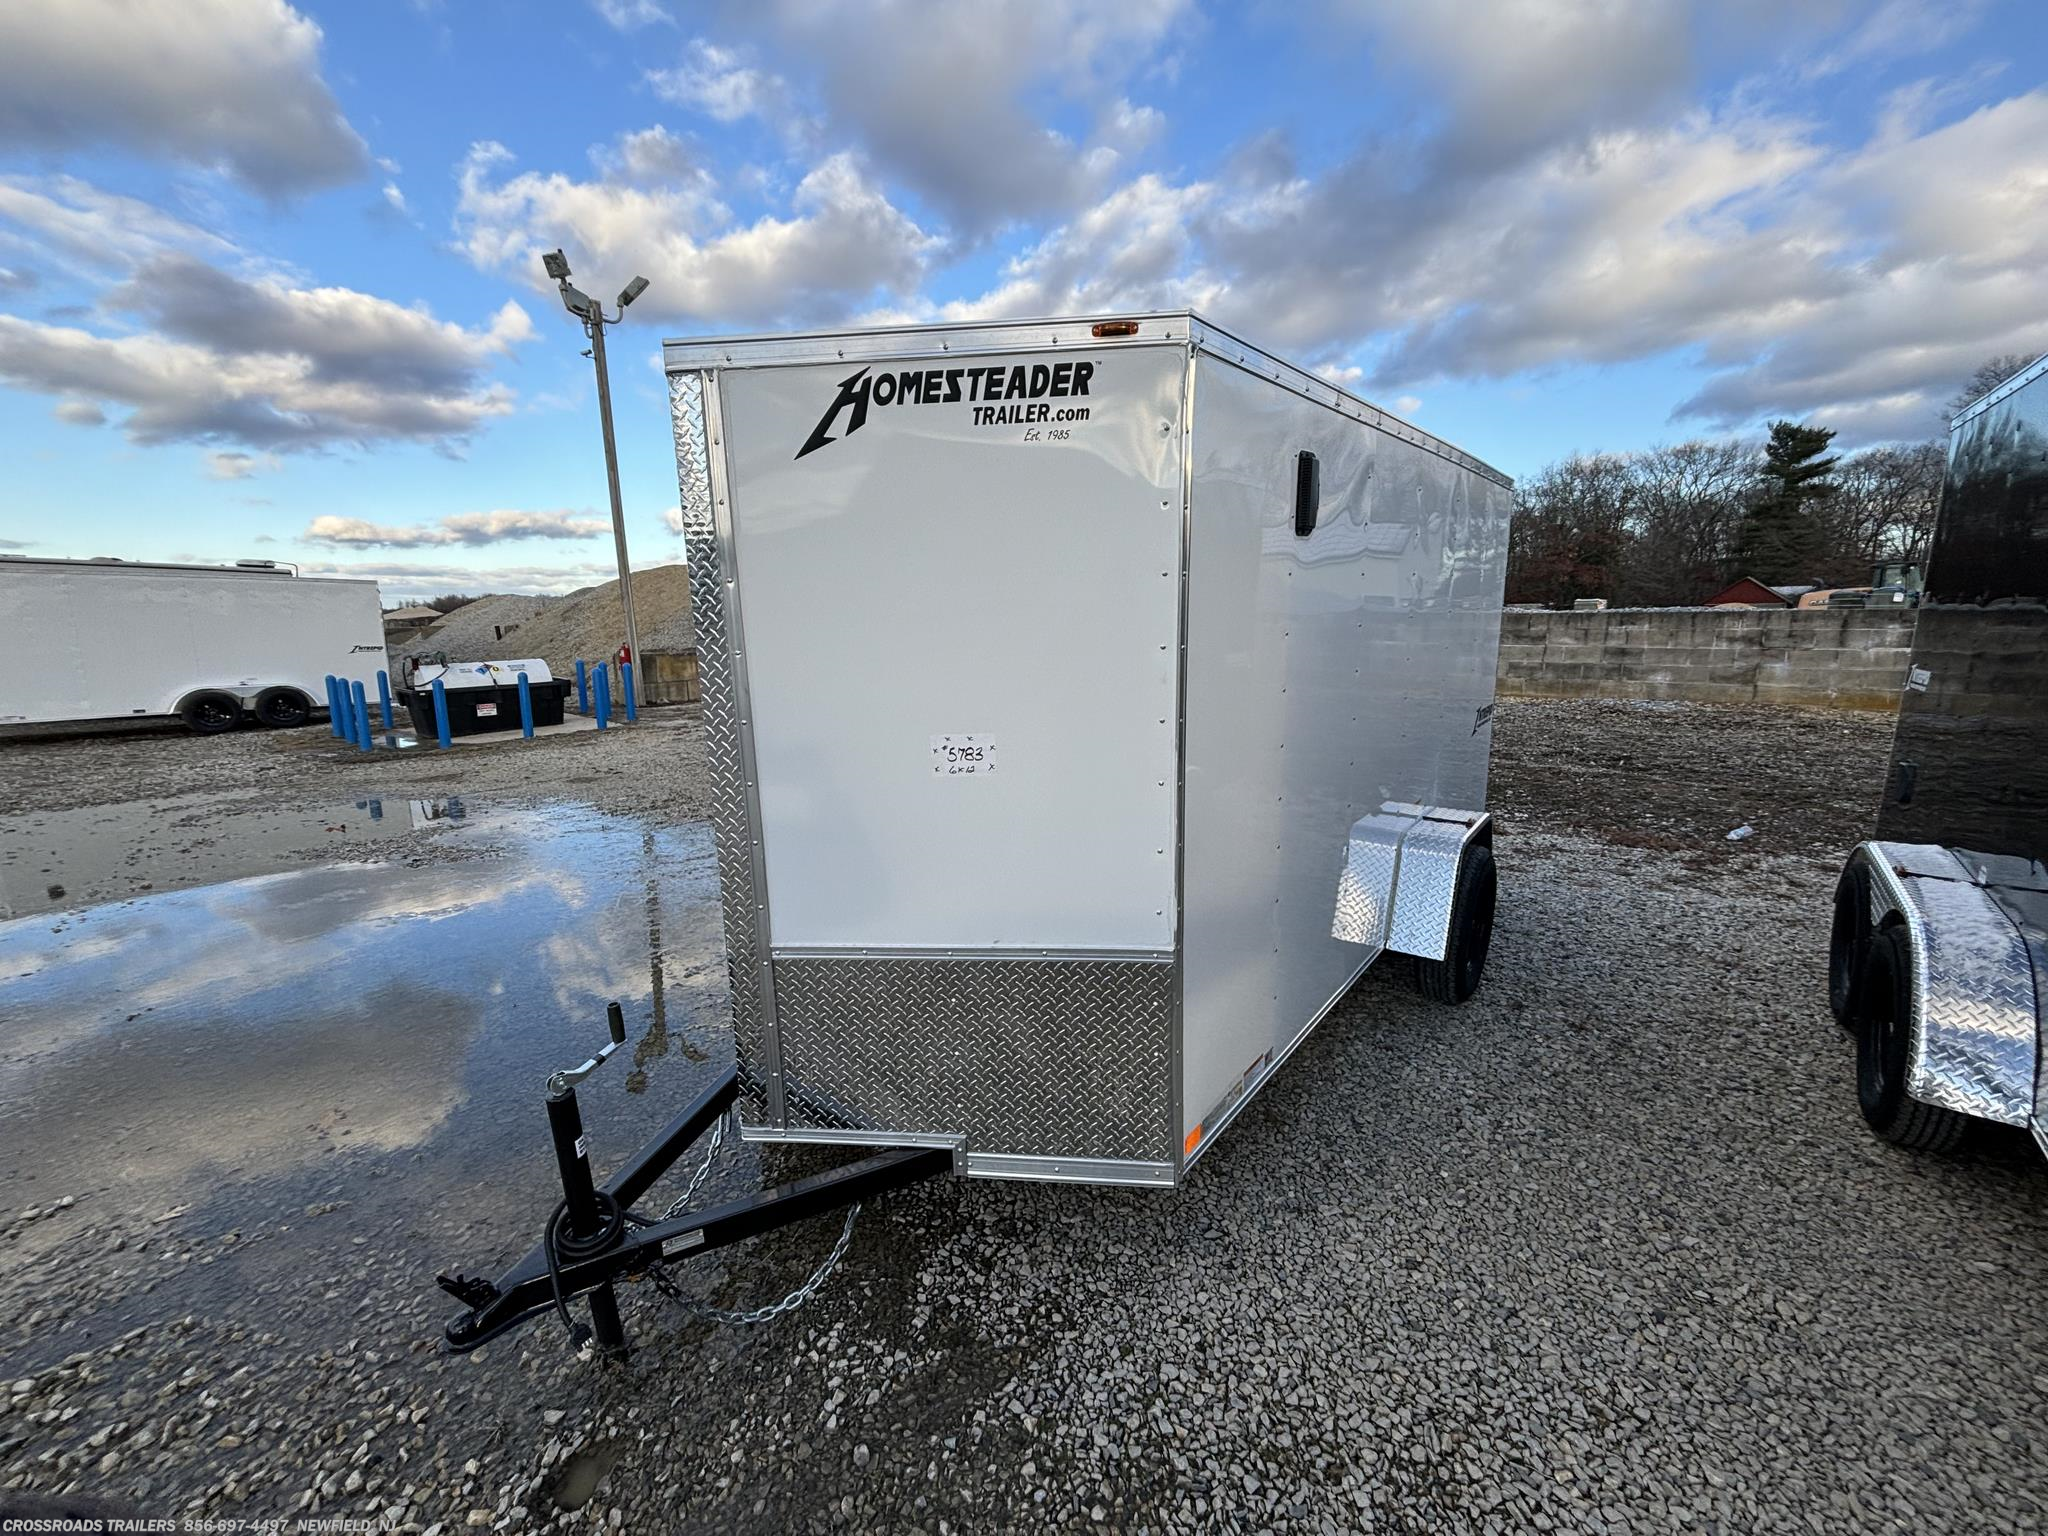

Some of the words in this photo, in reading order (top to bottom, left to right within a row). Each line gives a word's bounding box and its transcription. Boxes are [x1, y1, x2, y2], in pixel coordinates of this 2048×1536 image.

[793, 361, 1095, 461] HOMESTEADER
[973, 404, 1091, 426] TRAILER.com
[1024, 428, 1043, 442] Est.
[1048, 428, 1070, 441] 1985
